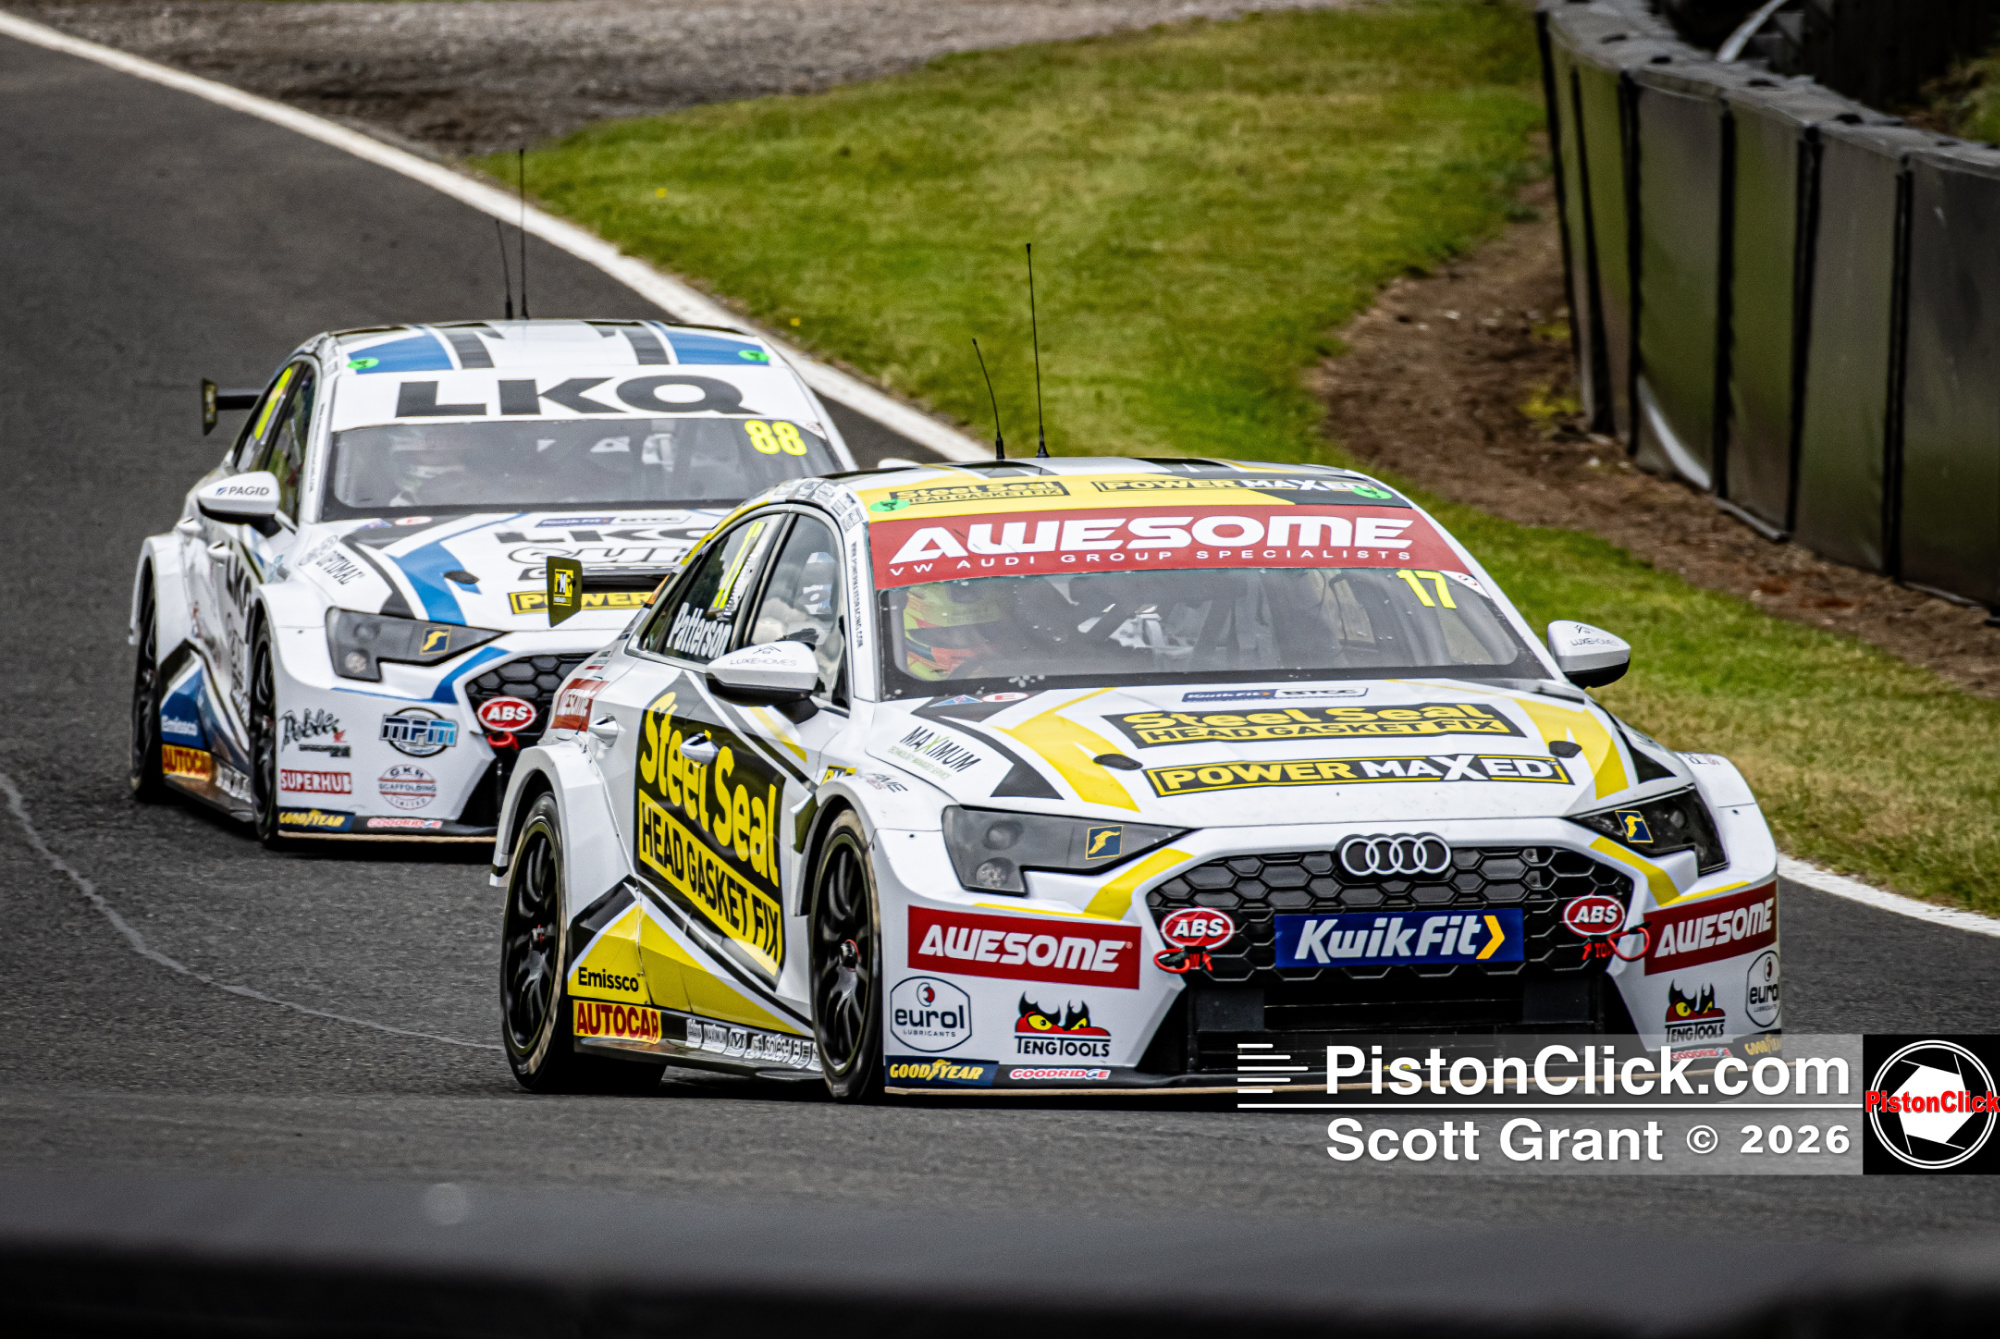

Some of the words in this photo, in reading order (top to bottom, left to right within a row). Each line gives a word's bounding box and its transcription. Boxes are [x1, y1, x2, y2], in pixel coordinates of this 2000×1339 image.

[396, 375, 765, 417] LKQ
[745, 420, 807, 456] 88
[229, 486, 270, 496] PAGID
[896, 485, 983, 500] Steel
[986, 481, 1060, 493] Seal
[1104, 479, 1240, 490] POWER
[889, 515, 1413, 565] AWESOME
[890, 562, 934, 577] VW
[956, 555, 1036, 569] AUDI
[1061, 550, 1173, 563] GROUP
[1196, 549, 1411, 561] SPECIALISTS
[517, 592, 653, 609] PWER
[1396, 569, 1458, 609] 17
[666, 602, 733, 659] Patterson
[486, 705, 528, 721] ABS
[1123, 708, 1322, 730] Steel
[1325, 704, 1495, 723] Seal
[1146, 726, 1259, 741] HEAD
[1265, 722, 1424, 736] GASKET
[1433, 719, 1499, 731] FIX
[900, 725, 982, 773] MAXIMUM
[281, 771, 351, 792] SUPERHUB
[1158, 759, 1358, 790] POWER
[1359, 753, 1555, 781] MAXED
[379, 783, 437, 792] SCAFFOLDING
[640, 691, 709, 833] Steel
[712, 745, 779, 888] Seal
[279, 809, 346, 828] GOODYEAR
[642, 801, 685, 882] HEAD
[686, 840, 748, 937] GASKET
[751, 892, 779, 963] FIX
[1574, 904, 1619, 925] ABS
[1172, 918, 1224, 937] ABS
[1654, 897, 1775, 959] AWESOME
[918, 923, 1127, 973] AWESOME
[578, 966, 639, 993] Emissco
[1750, 982, 1781, 1004] euro
[576, 1002, 659, 1042] AUTOCAR
[895, 1004, 965, 1029] eurol
[903, 1029, 957, 1038] LUBRICANTS
[889, 1058, 984, 1081] GOODYEAR
[1009, 1067, 1111, 1080] GOODRIDGE
